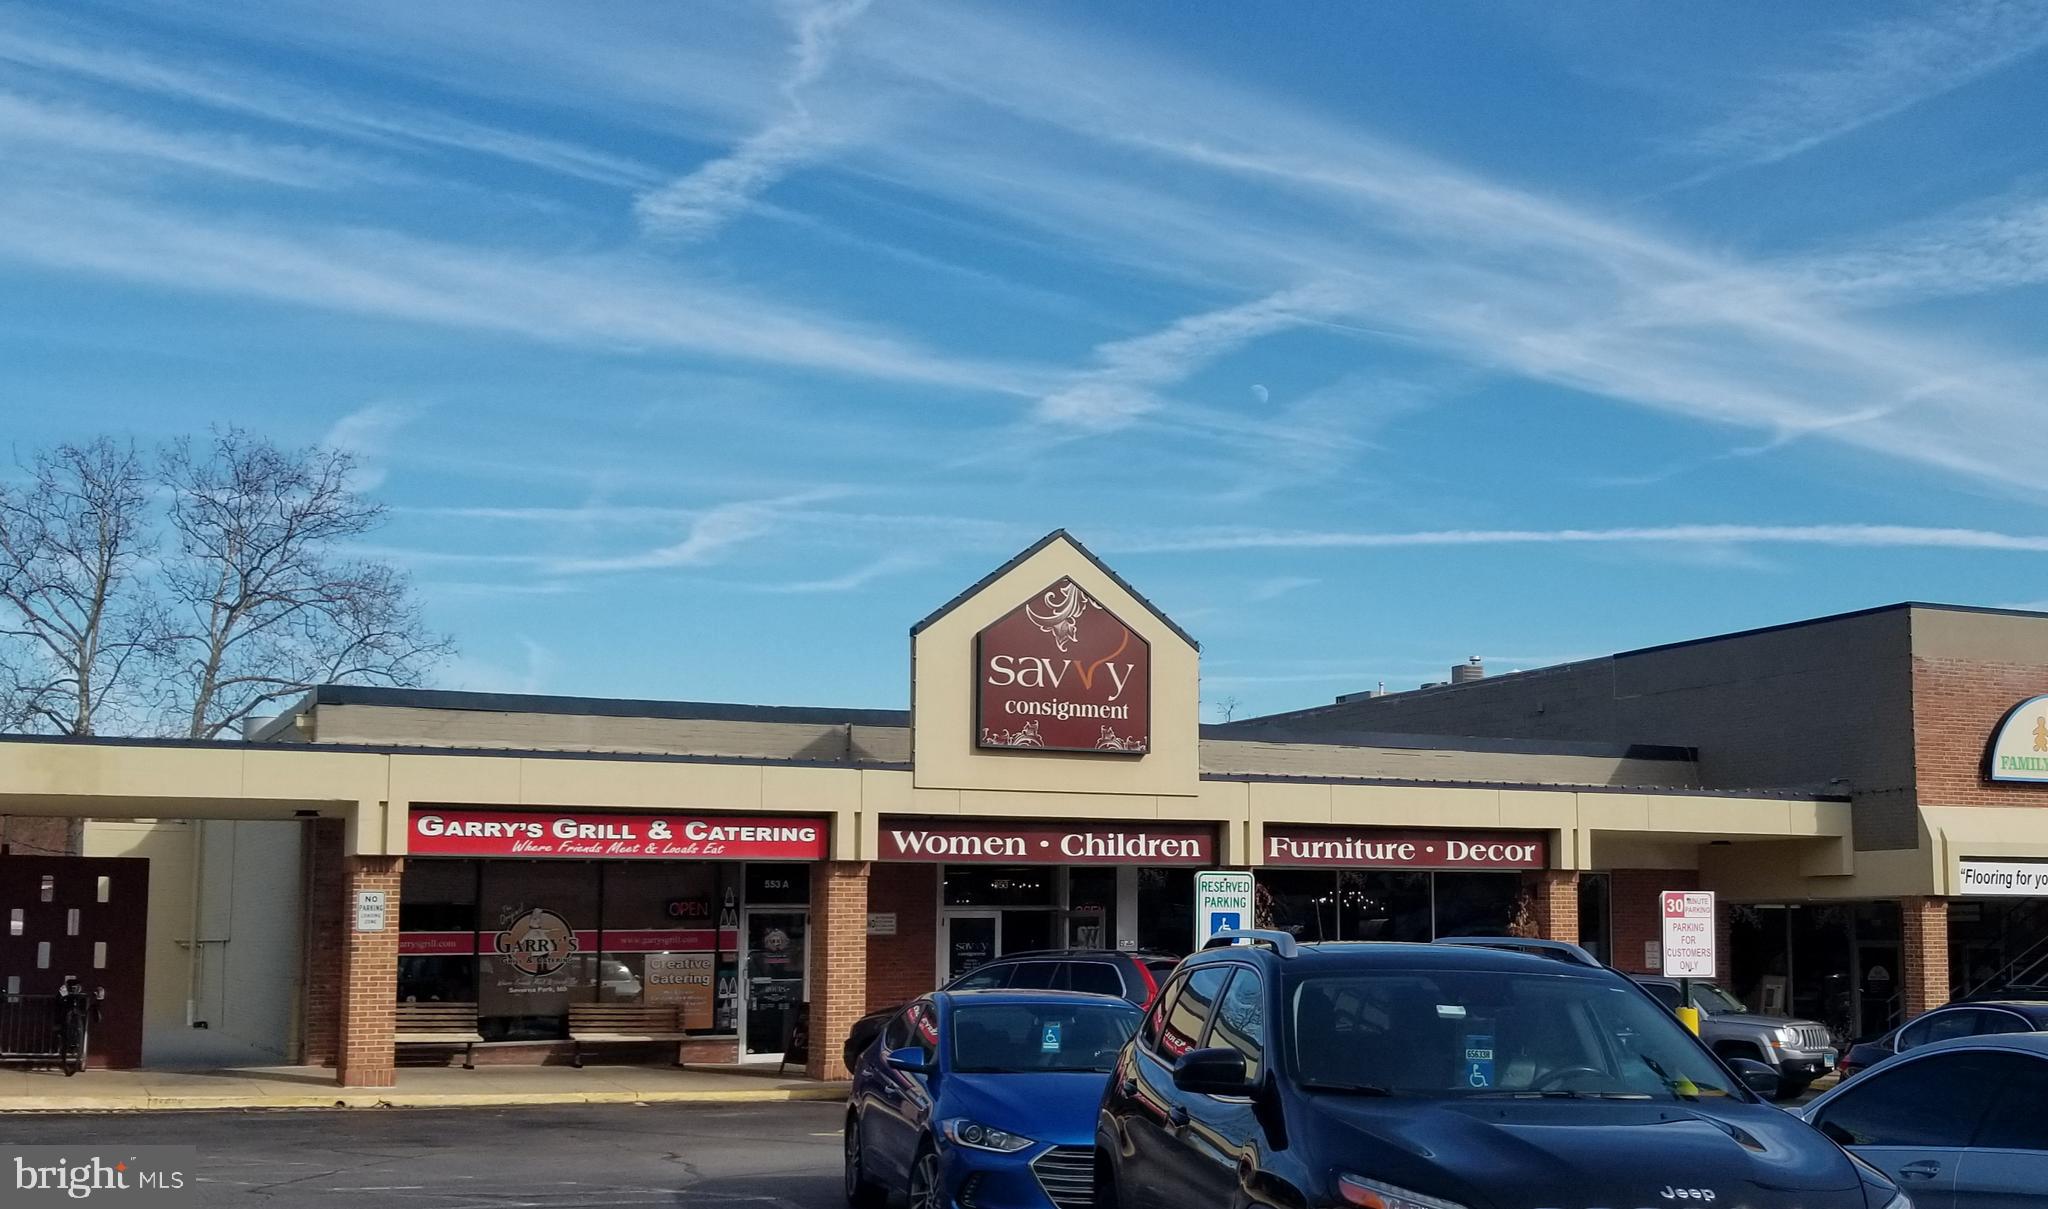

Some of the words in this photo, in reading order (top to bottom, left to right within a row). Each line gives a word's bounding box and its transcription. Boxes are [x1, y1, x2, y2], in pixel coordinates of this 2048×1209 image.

[1004, 698, 1129, 721] consignment
[417, 815, 544, 838] GARRY'S
[552, 818, 637, 840] GRILL
[648, 820, 673, 840] &
[685, 821, 816, 842] CATERING
[512, 840, 553, 853] Where
[558, 841, 602, 853] Friends
[605, 842, 640, 854] Meet
[644, 842, 658, 854] &
[662, 842, 700, 854] Locals
[702, 843, 725, 854] Eat
[891, 830, 1027, 856] Women
[1060, 833, 1201, 857] Children
[1269, 836, 1416, 861] Furniture
[1445, 840, 1536, 862] Decor
[764, 879, 781, 888] 553
[782, 879, 790, 888] A
[2016, 869, 2033, 886] for
[2035, 873, 2048, 890] yo
[1201, 881, 1250, 893] RESERVED
[669, 902, 708, 916] OPEN
[1204, 897, 1247, 908] PARKING
[1666, 898, 1684, 913] 30
[1685, 906, 1710, 914] PARKING
[1672, 923, 1705, 932] PARKING
[495, 931, 579, 954] GARRY'S
[1681, 935, 1696, 944] FOR
[1667, 948, 1711, 958] CUSTOMERS
[651, 958, 711, 969] Creative
[1680, 961, 1699, 970] ONLY
[650, 973, 711, 986] Catering
[1660, 1185, 1716, 1201] Jeep
